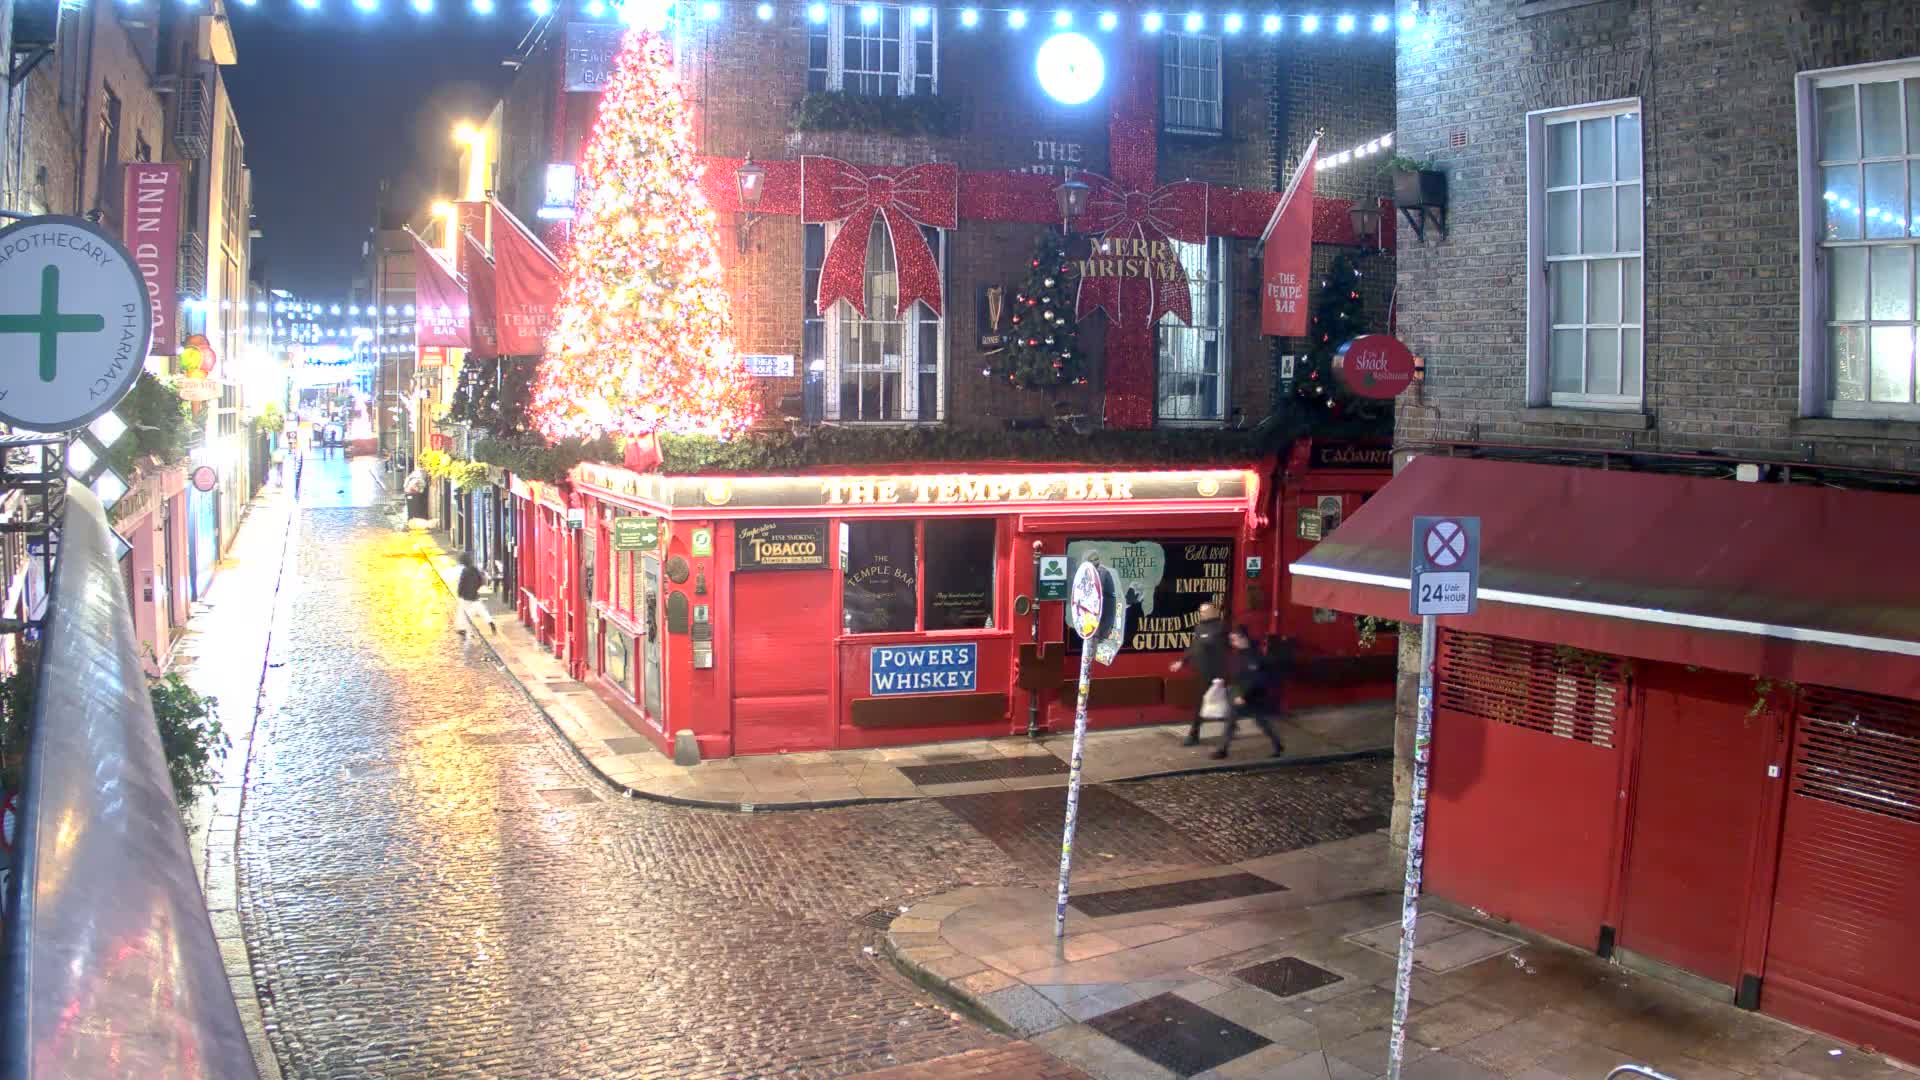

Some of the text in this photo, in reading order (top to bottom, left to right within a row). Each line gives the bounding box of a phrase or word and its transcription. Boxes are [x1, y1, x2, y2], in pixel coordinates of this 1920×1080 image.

[1033, 141, 1081, 162] THE
[137, 172, 169, 232] NINE
[1278, 272, 1296, 284] THE
[520, 304, 545, 313] THE
[1275, 299, 1296, 313] BAR
[88, 303, 137, 401] PHARMACY
[1356, 350, 1388, 371] Shack
[822, 474, 1134, 505] THE TEMPLE BAR
[748, 538, 816, 562] TOBACCO
[1122, 547, 1146, 558] THE
[1111, 557, 1156, 568] TEMPLE
[1203, 563, 1227, 577] THE
[847, 565, 914, 588] TEMPLE BAR
[1121, 568, 1145, 579] BAR
[1175, 578, 1227, 593] EMPEROR
[1422, 583, 1444, 602] 24
[1444, 594, 1467, 602] HOUR
[1137, 616, 1181, 631] MALTED
[1132, 632, 1194, 650] GUINN
[879, 648, 969, 668] POWER'S
[873, 671, 974, 690] WHISKEY
